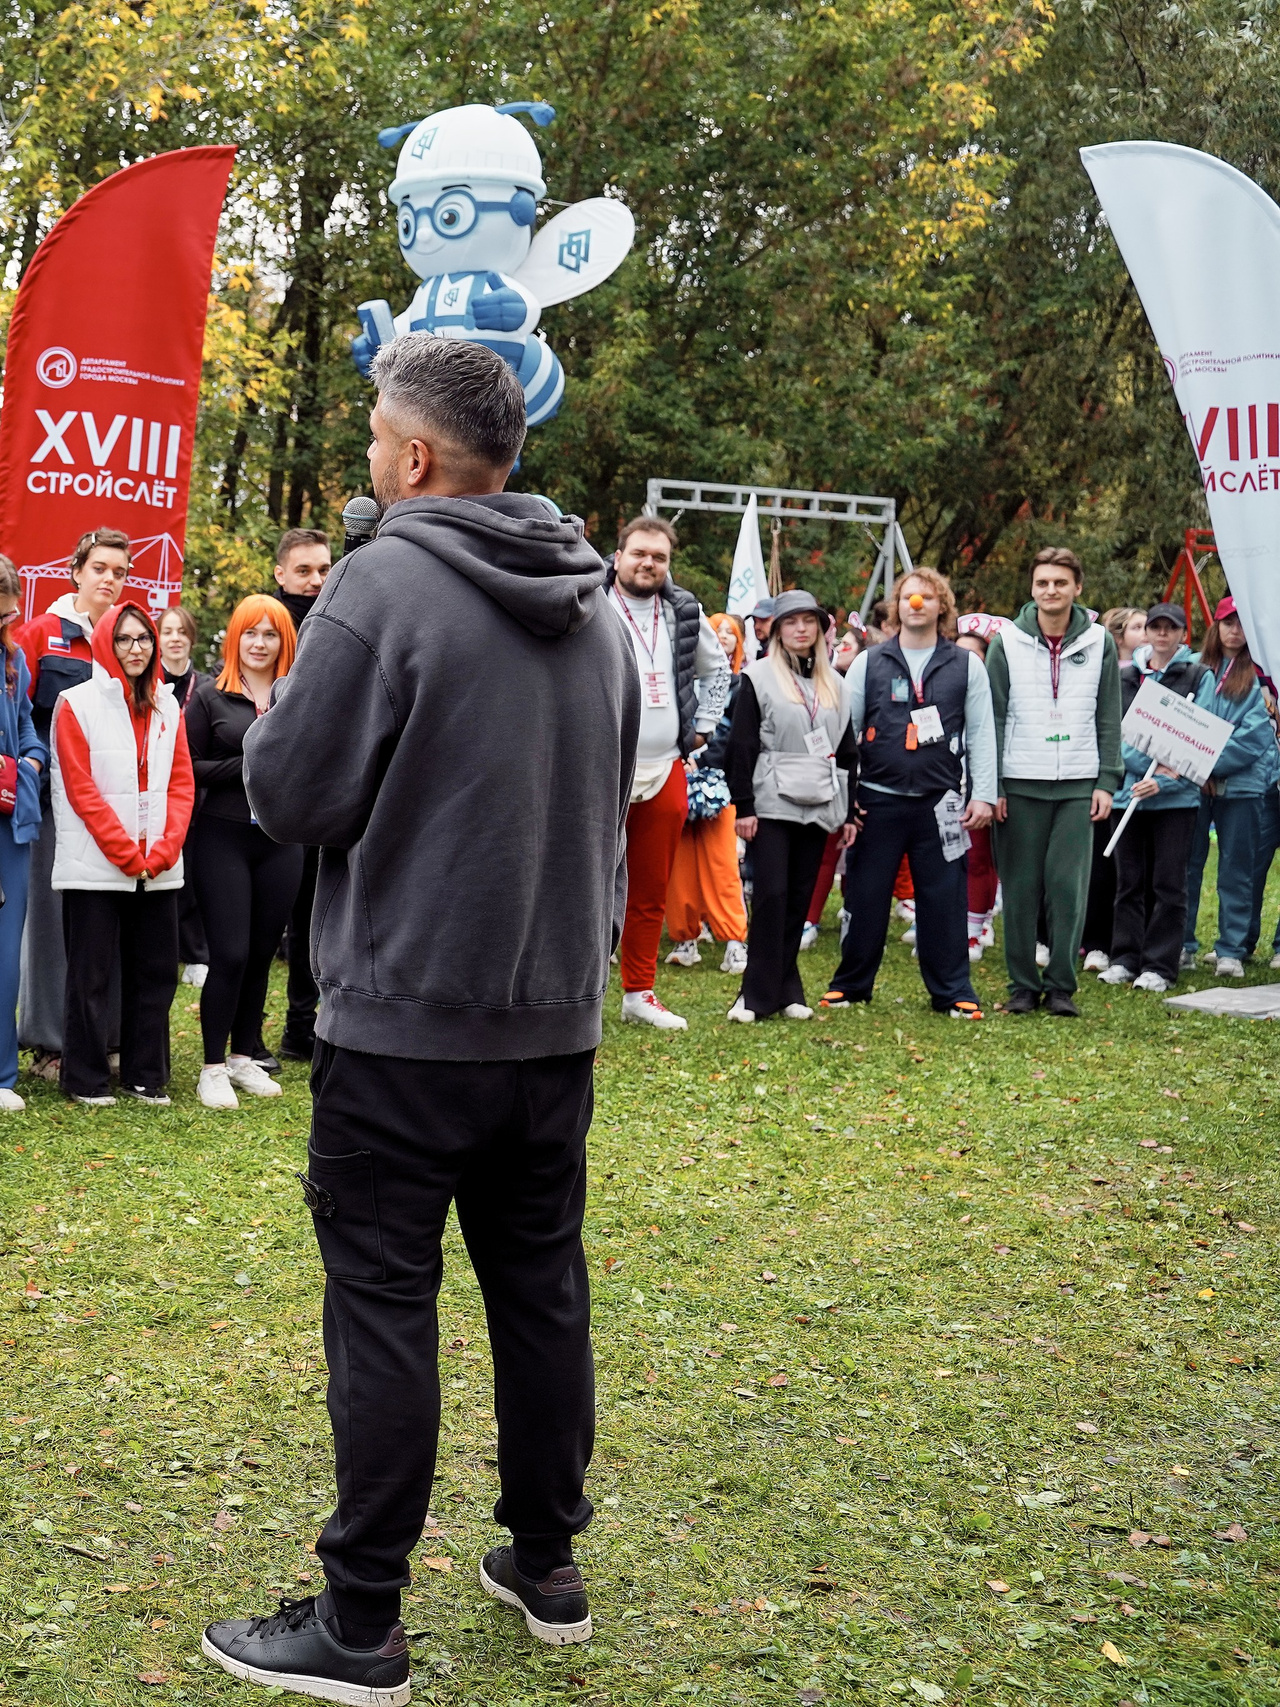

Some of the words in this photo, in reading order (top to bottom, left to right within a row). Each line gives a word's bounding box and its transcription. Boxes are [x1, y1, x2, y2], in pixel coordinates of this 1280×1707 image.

[80, 365, 151, 380] ГРАДОСТРОИТЕЛЬНОЙ
[151, 374, 185, 387] ПОЛИТИКИ
[80, 372, 107, 381] ГОРОДА
[108, 374, 139, 385] МОСКВЫ
[81, 357, 127, 368] ДЕПАРТАМЕНТ
[30, 409, 181, 479] XVIII
[1183, 403, 1280, 462] VIII
[26, 469, 178, 509] СТРОЙСЛЁТ
[1135, 707, 1160, 727] ФОНД
[1161, 723, 1215, 756] РЕНОВАЦИИ
